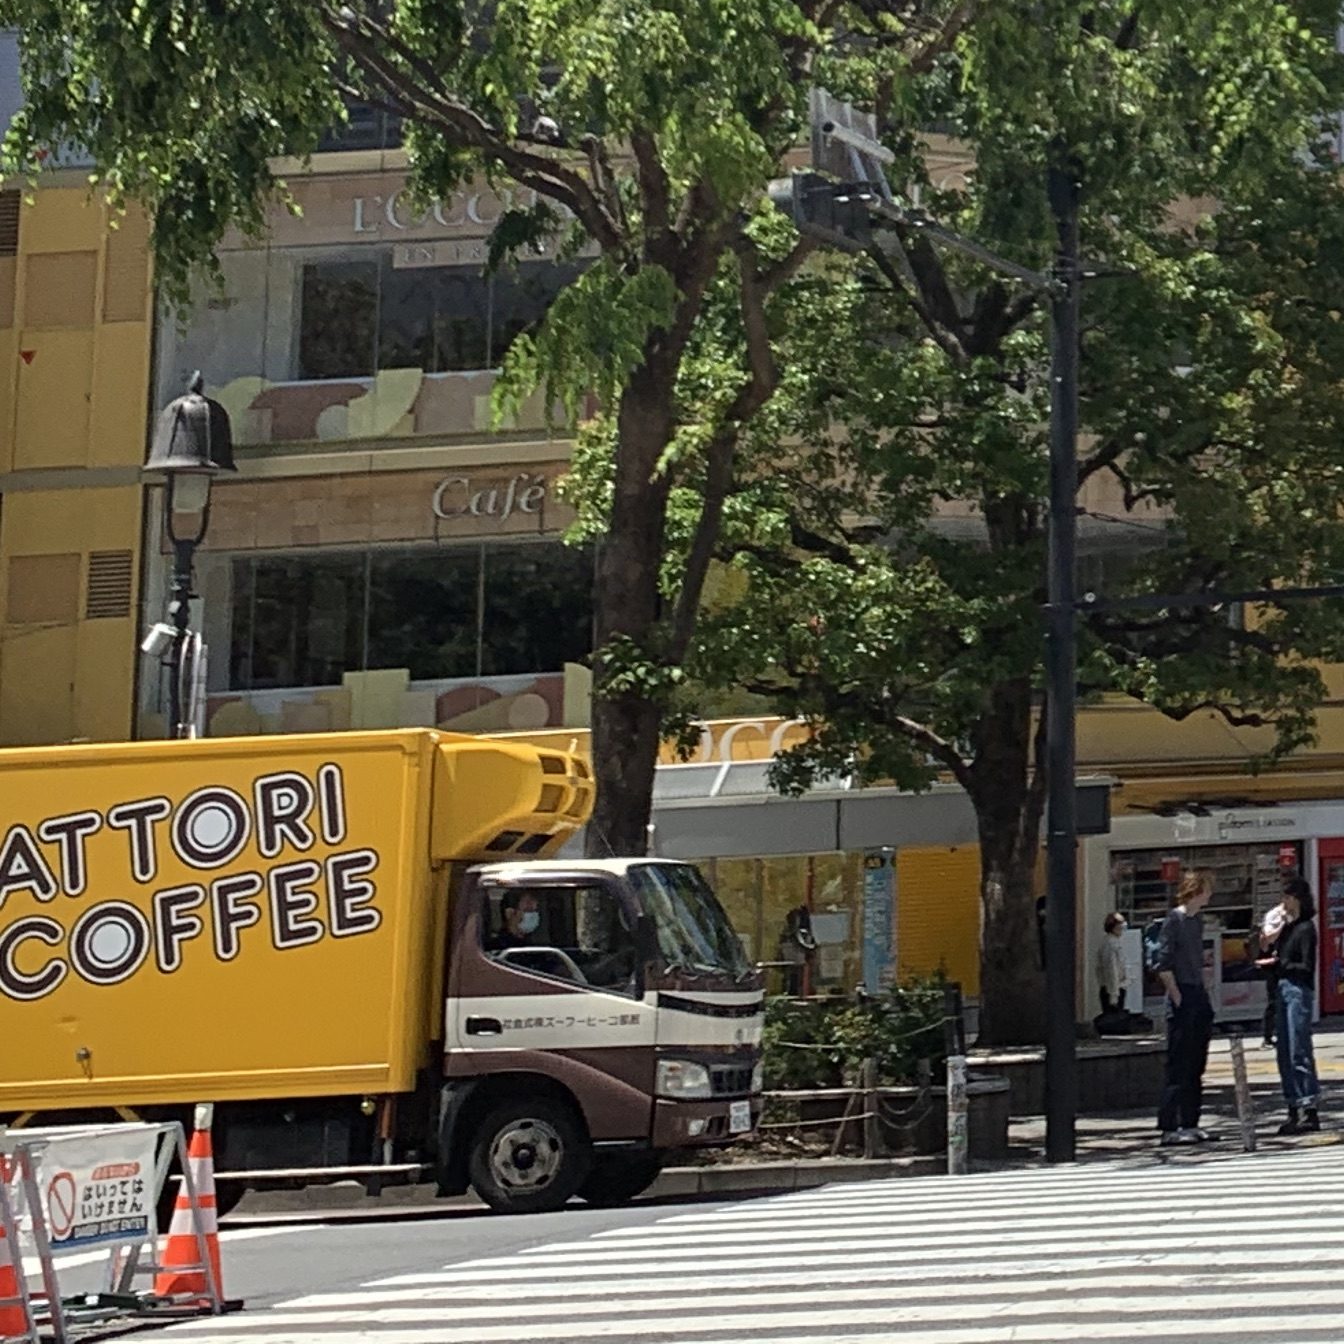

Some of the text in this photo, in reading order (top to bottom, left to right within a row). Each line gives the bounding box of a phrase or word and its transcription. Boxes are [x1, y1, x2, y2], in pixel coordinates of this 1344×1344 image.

[431, 474, 547, 521] Café
[0, 851, 383, 999] COFFEE
[81, 1197, 143, 1219] いけません
[83, 1179, 144, 1202] はいっては
